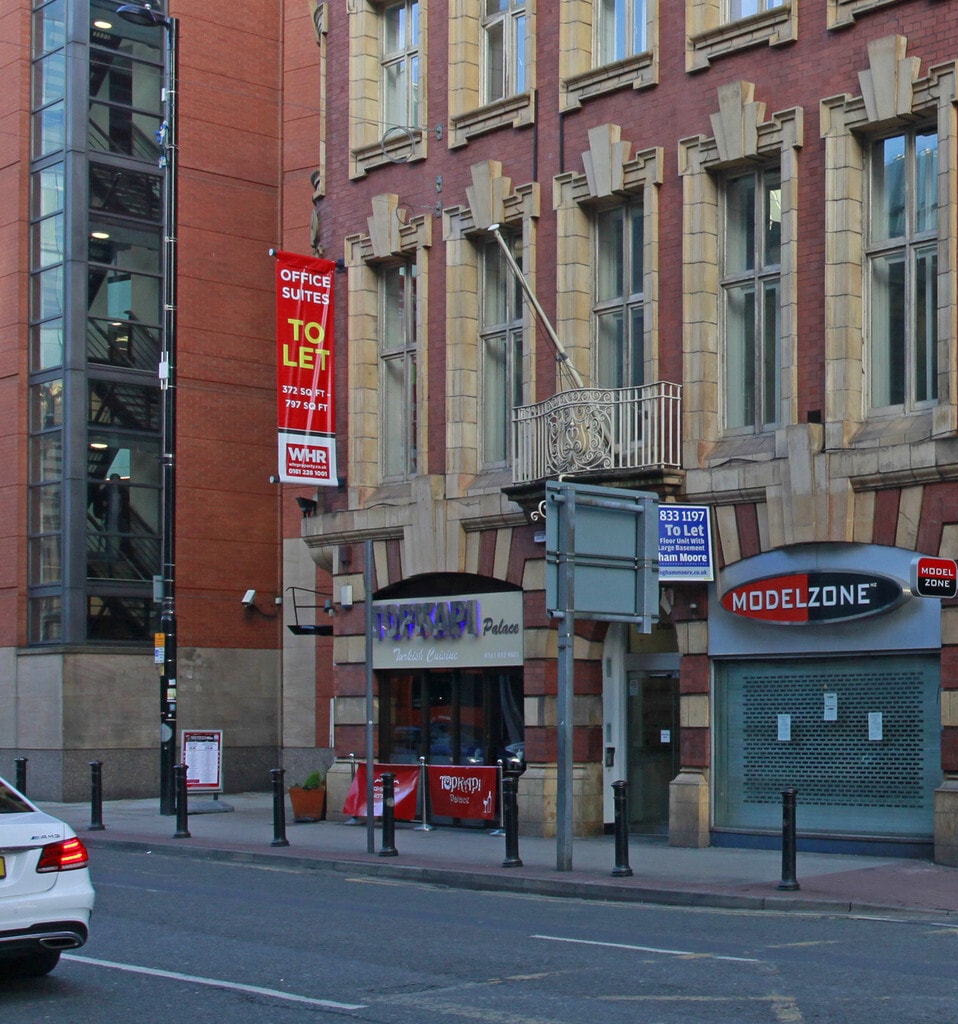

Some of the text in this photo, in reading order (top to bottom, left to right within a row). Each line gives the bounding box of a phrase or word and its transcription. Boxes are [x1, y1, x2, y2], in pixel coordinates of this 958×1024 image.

[280, 269, 331, 289] OFFICE
[282, 286, 330, 305] SUITES
[287, 317, 326, 345] TO
[282, 343, 330, 371] LET
[282, 385, 298, 395] 372
[300, 387, 312, 396] SQ
[315, 389, 325, 398] FT
[285, 399, 328, 412] 797 SQ FT
[288, 446, 327, 464] WHR
[659, 510, 705, 522] 833 1197
[664, 524, 705, 537] To Let
[690, 537, 705, 545] With
[679, 553, 707, 562] Moore
[921, 566, 954, 577] MODEL
[924, 577, 951, 588] ZONE
[732, 582, 870, 612] MODELZONE
[372, 600, 519, 641] TOPKAPI Palace
[393, 647, 459, 663] Turkish Cuisine
